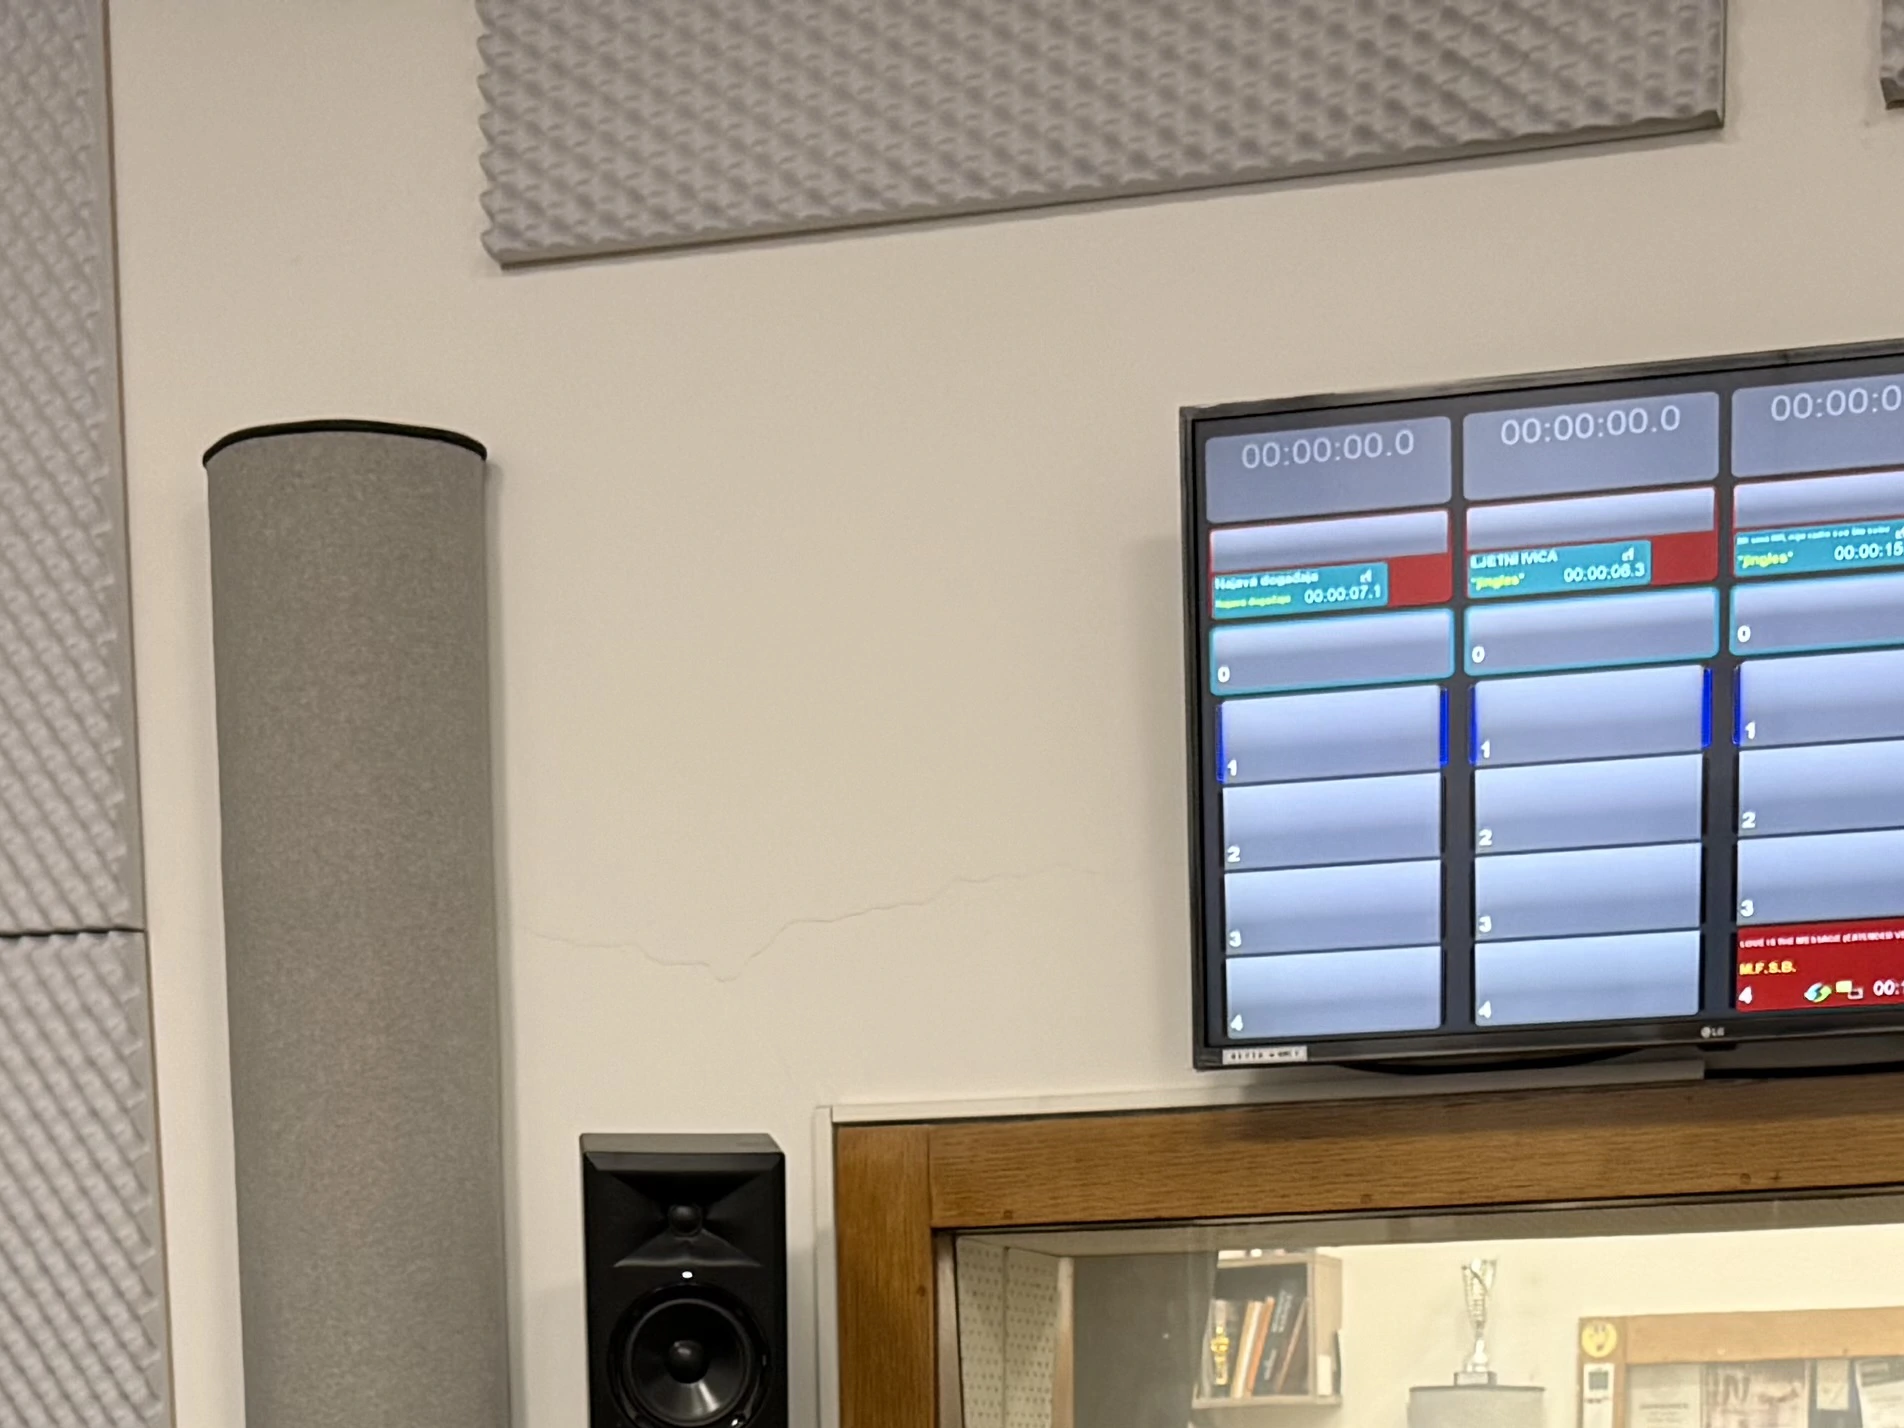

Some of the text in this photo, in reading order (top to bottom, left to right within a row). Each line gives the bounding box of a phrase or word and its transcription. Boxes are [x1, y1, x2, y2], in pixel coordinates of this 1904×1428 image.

[1500, 405, 1680, 445] 00:00:00.0
[1242, 429, 1414, 468] 00:00:00.0
[1304, 584, 1382, 604] 00:00:07.1
[1737, 625, 1751, 642] 0
[1471, 646, 1485, 664] 0
[1217, 666, 1231, 683] 0
[1744, 722, 1757, 739] 1
[1480, 740, 1491, 758] 1
[1227, 759, 1238, 777] 1
[1741, 812, 1756, 829] 2
[1479, 829, 1493, 846] 2
[1227, 846, 1241, 863] 2
[1740, 900, 1754, 917] 3
[1479, 916, 1492, 933] 3
[1229, 930, 1243, 947] 3
[1739, 985, 1753, 1004] 4
[1478, 1001, 1492, 1019] 4
[1230, 1014, 1244, 1031] 4
